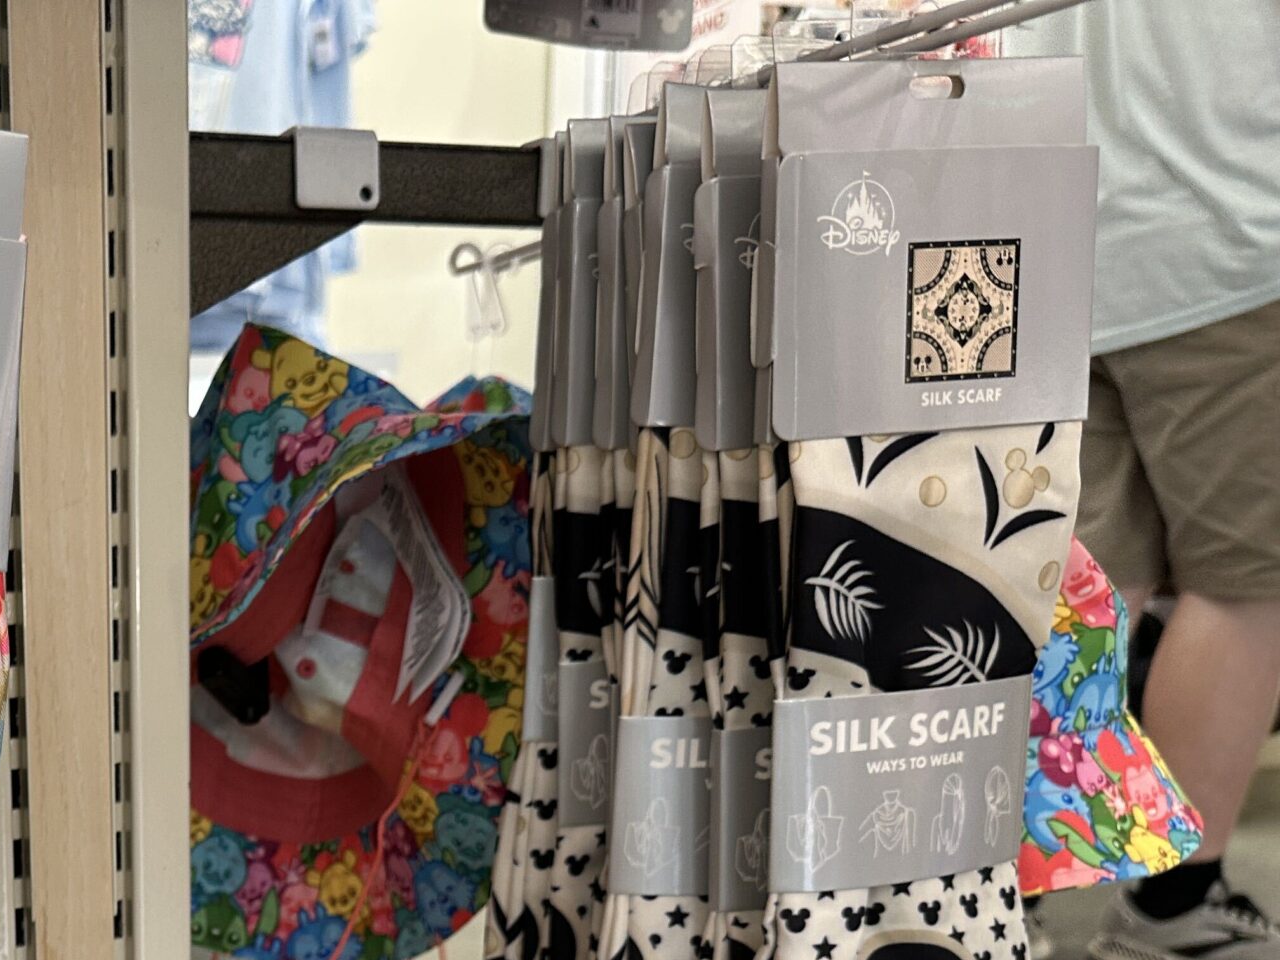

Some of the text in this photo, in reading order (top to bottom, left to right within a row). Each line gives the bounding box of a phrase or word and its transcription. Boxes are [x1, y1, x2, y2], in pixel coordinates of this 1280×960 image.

[921, 387, 1003, 407] SILK SCARF
[809, 702, 1006, 756] SILK SCARF
[649, 737, 708, 769] SIL
[866, 751, 964, 774] WAYS TO WEAR
